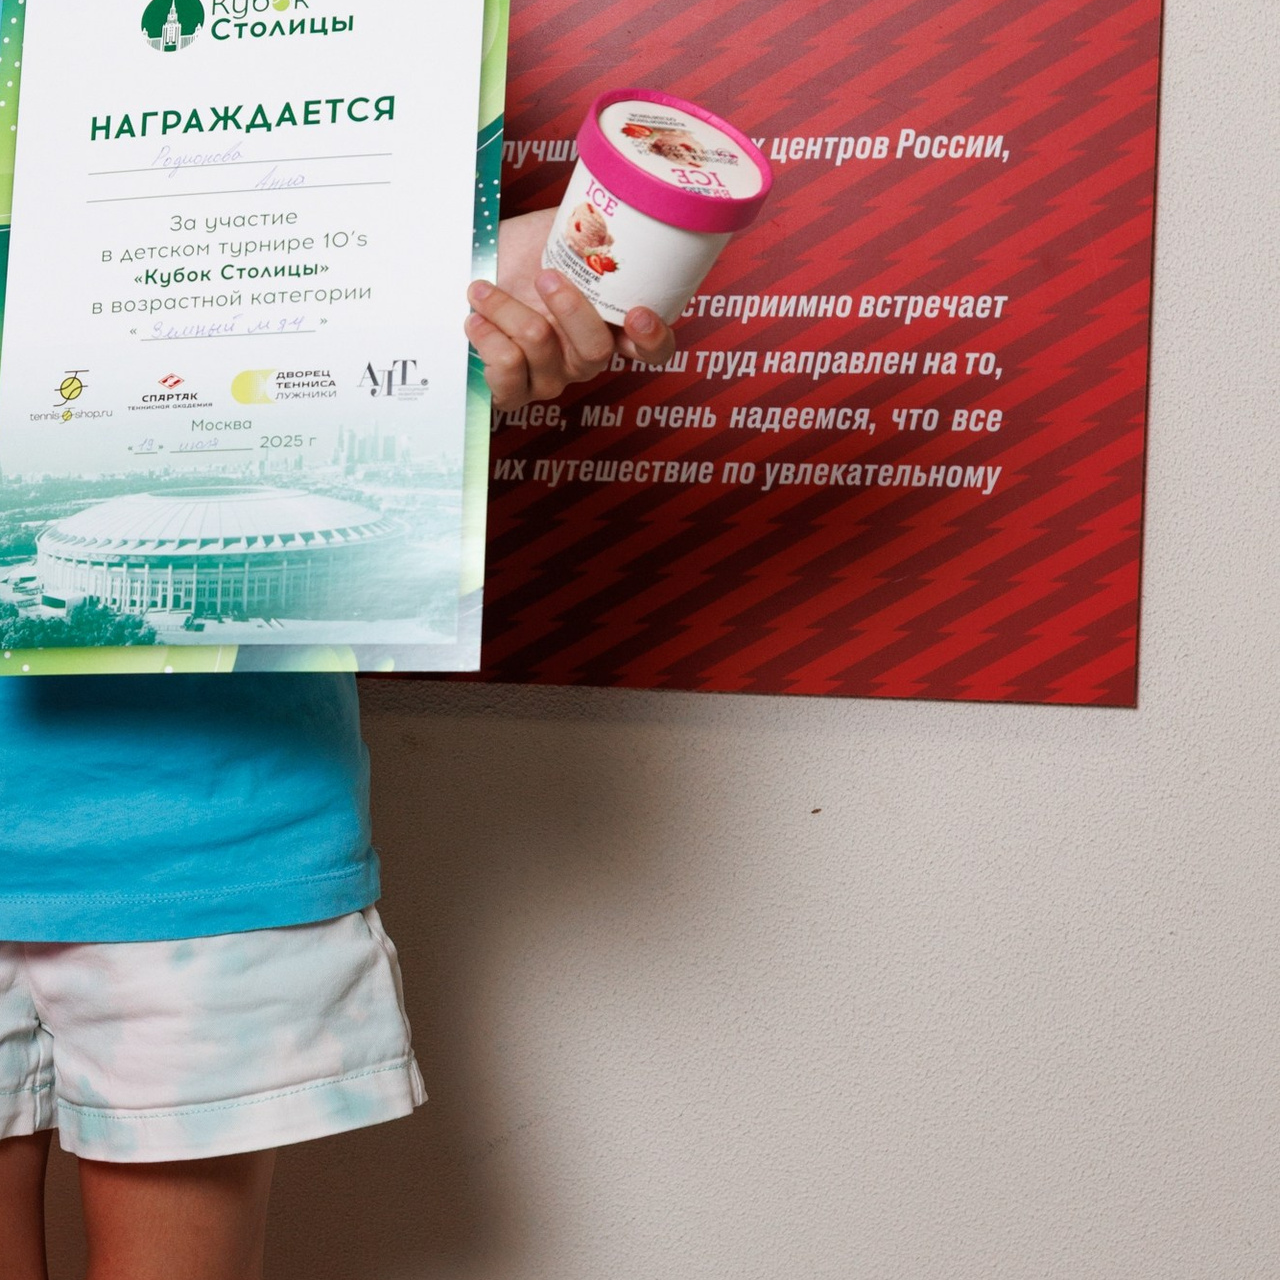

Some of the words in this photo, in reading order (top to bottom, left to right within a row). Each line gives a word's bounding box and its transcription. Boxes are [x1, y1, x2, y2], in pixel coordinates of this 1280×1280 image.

[211, 16, 353, 40] Столицы
[91, 96, 394, 139] НАГРАЖДАЕТСЯ
[770, 136, 890, 166] центров
[896, 128, 1009, 162] России,
[586, 179, 619, 217] ICE
[169, 214, 197, 233] За
[205, 211, 298, 234] участие
[101, 249, 113, 263] в
[119, 243, 210, 263] детском
[218, 237, 315, 259] турнире
[134, 266, 212, 289] «Кубок
[220, 263, 329, 281] Столицы»
[91, 301, 103, 315] в
[110, 290, 242, 315] возрастной
[250, 287, 372, 305] категории
[858, 295, 1008, 324] встречает
[276, 369, 331, 380] ДВОРЕЦ
[695, 350, 758, 380] труд
[762, 350, 918, 380] направлен
[922, 351, 958, 376] на
[964, 351, 1003, 381] то,
[141, 392, 198, 404] СПАРТАК
[275, 390, 337, 401] ЛУЖНИКИ
[276, 380, 337, 390] ТЕННИСА
[190, 419, 253, 432] Москва
[581, 405, 625, 427] мы
[635, 405, 717, 429] очень
[729, 406, 876, 434] надеемся,
[891, 407, 940, 432] что
[950, 408, 1004, 433] все
[259, 434, 304, 450] 2025
[493, 459, 527, 481] их
[534, 459, 714, 487] путешествие
[721, 461, 757, 485] по
[762, 462, 1002, 495] увлекательному
